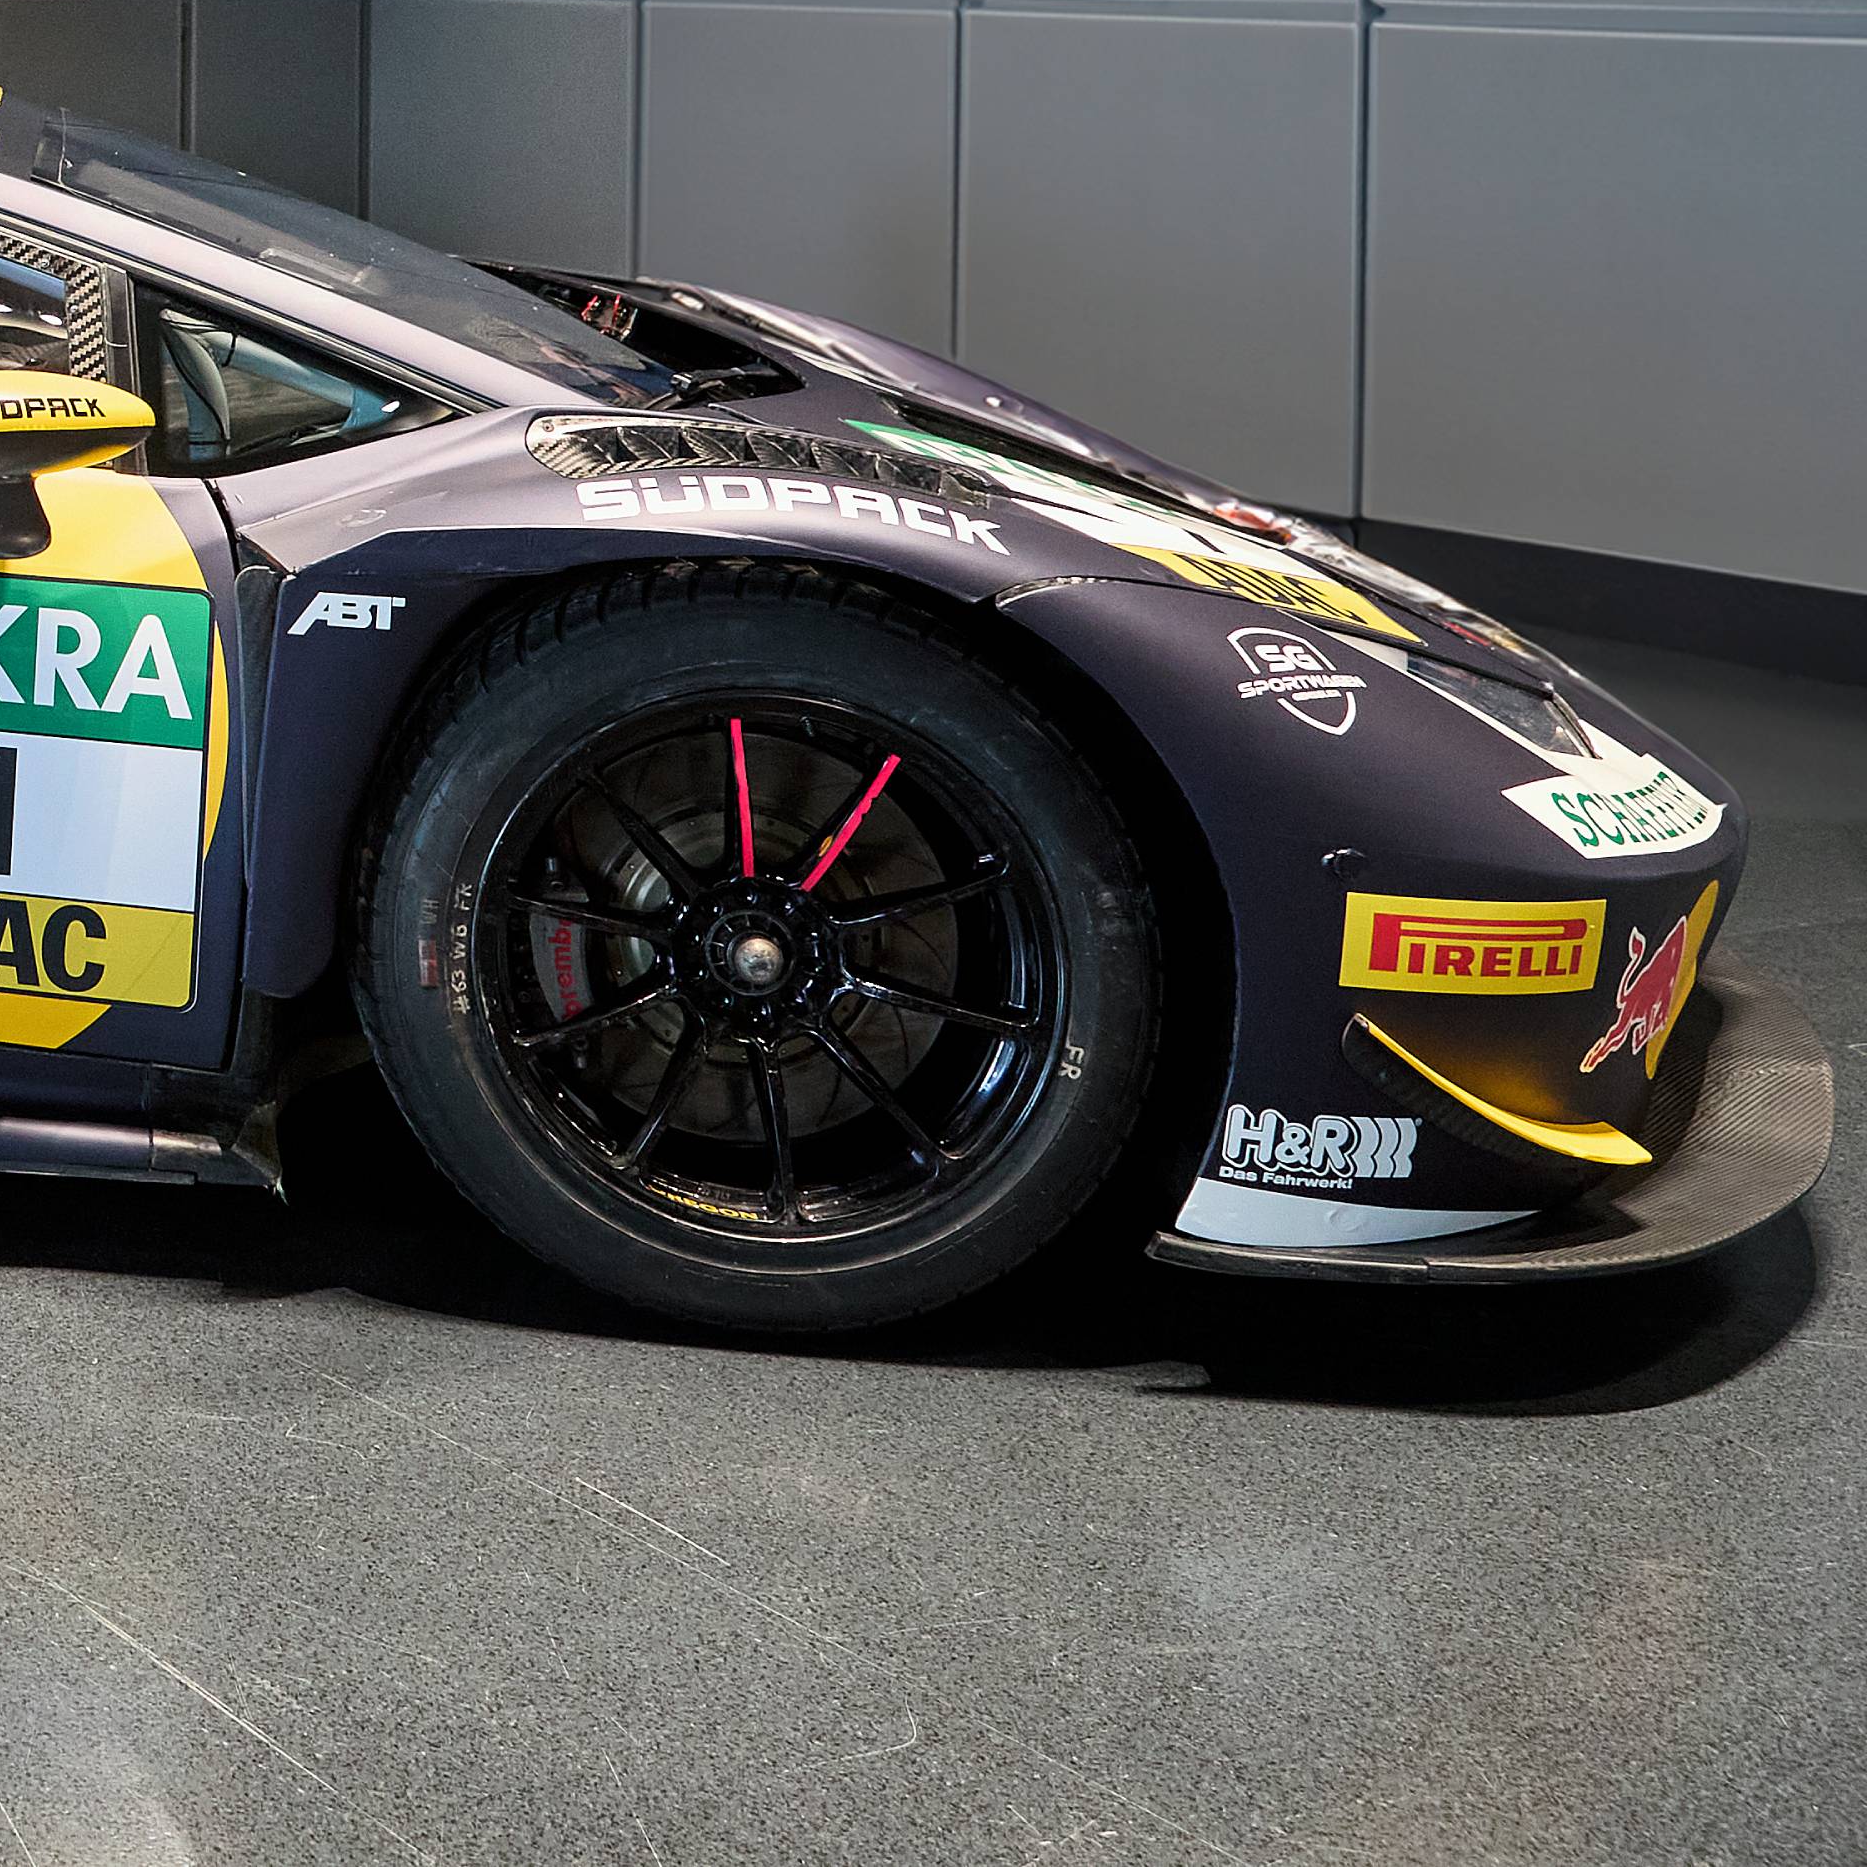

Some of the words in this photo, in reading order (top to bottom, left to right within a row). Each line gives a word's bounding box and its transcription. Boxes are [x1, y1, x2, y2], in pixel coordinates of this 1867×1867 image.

[576, 474, 1011, 556] SÜDPACK
[287, 591, 406, 636] ABT
[1254, 644, 1324, 673] SG
[1237, 674, 1368, 699] SPORTWAGEN
[1368, 913, 1588, 978] PIRELLI
[1221, 1103, 1360, 1179] H&R
[1219, 1165, 1258, 1182] Das
[1261, 1171, 1354, 1190] Fahrwerk!
